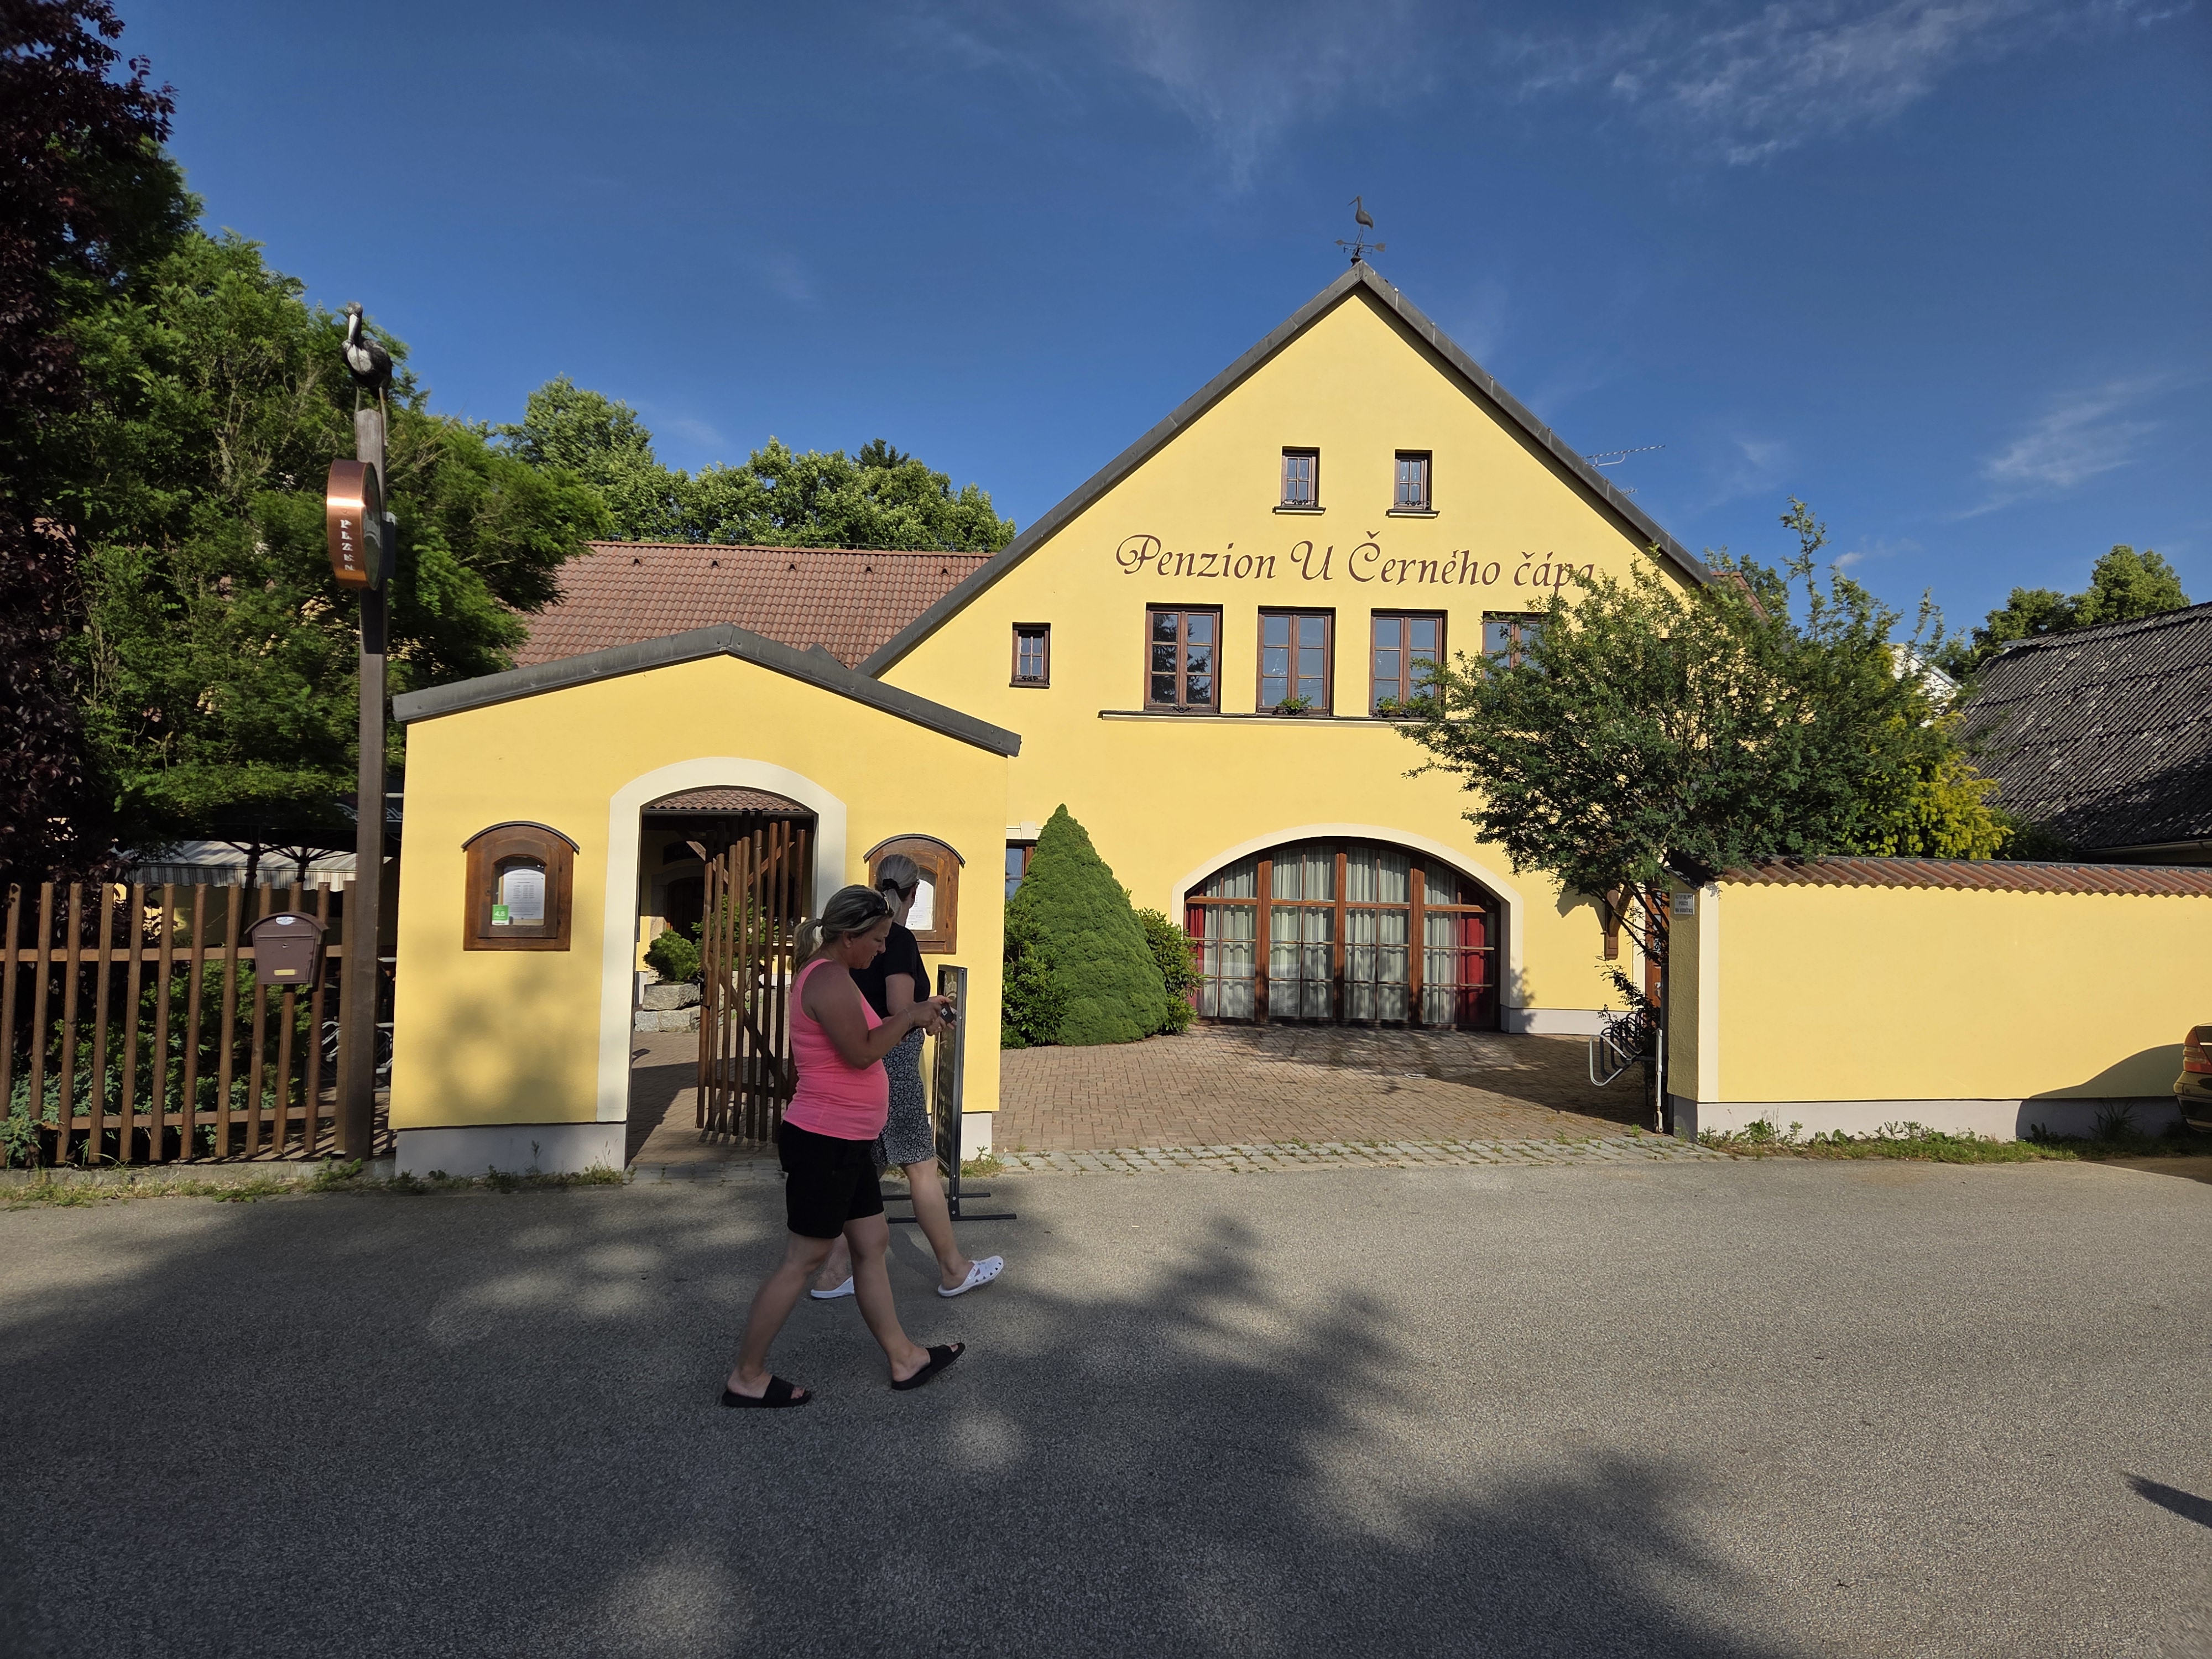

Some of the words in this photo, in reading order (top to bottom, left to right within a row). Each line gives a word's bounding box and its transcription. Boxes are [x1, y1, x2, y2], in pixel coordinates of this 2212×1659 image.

[1116, 534, 1276, 579] Penzion
[1290, 540, 1333, 581] U
[1348, 530, 1501, 585] Černého
